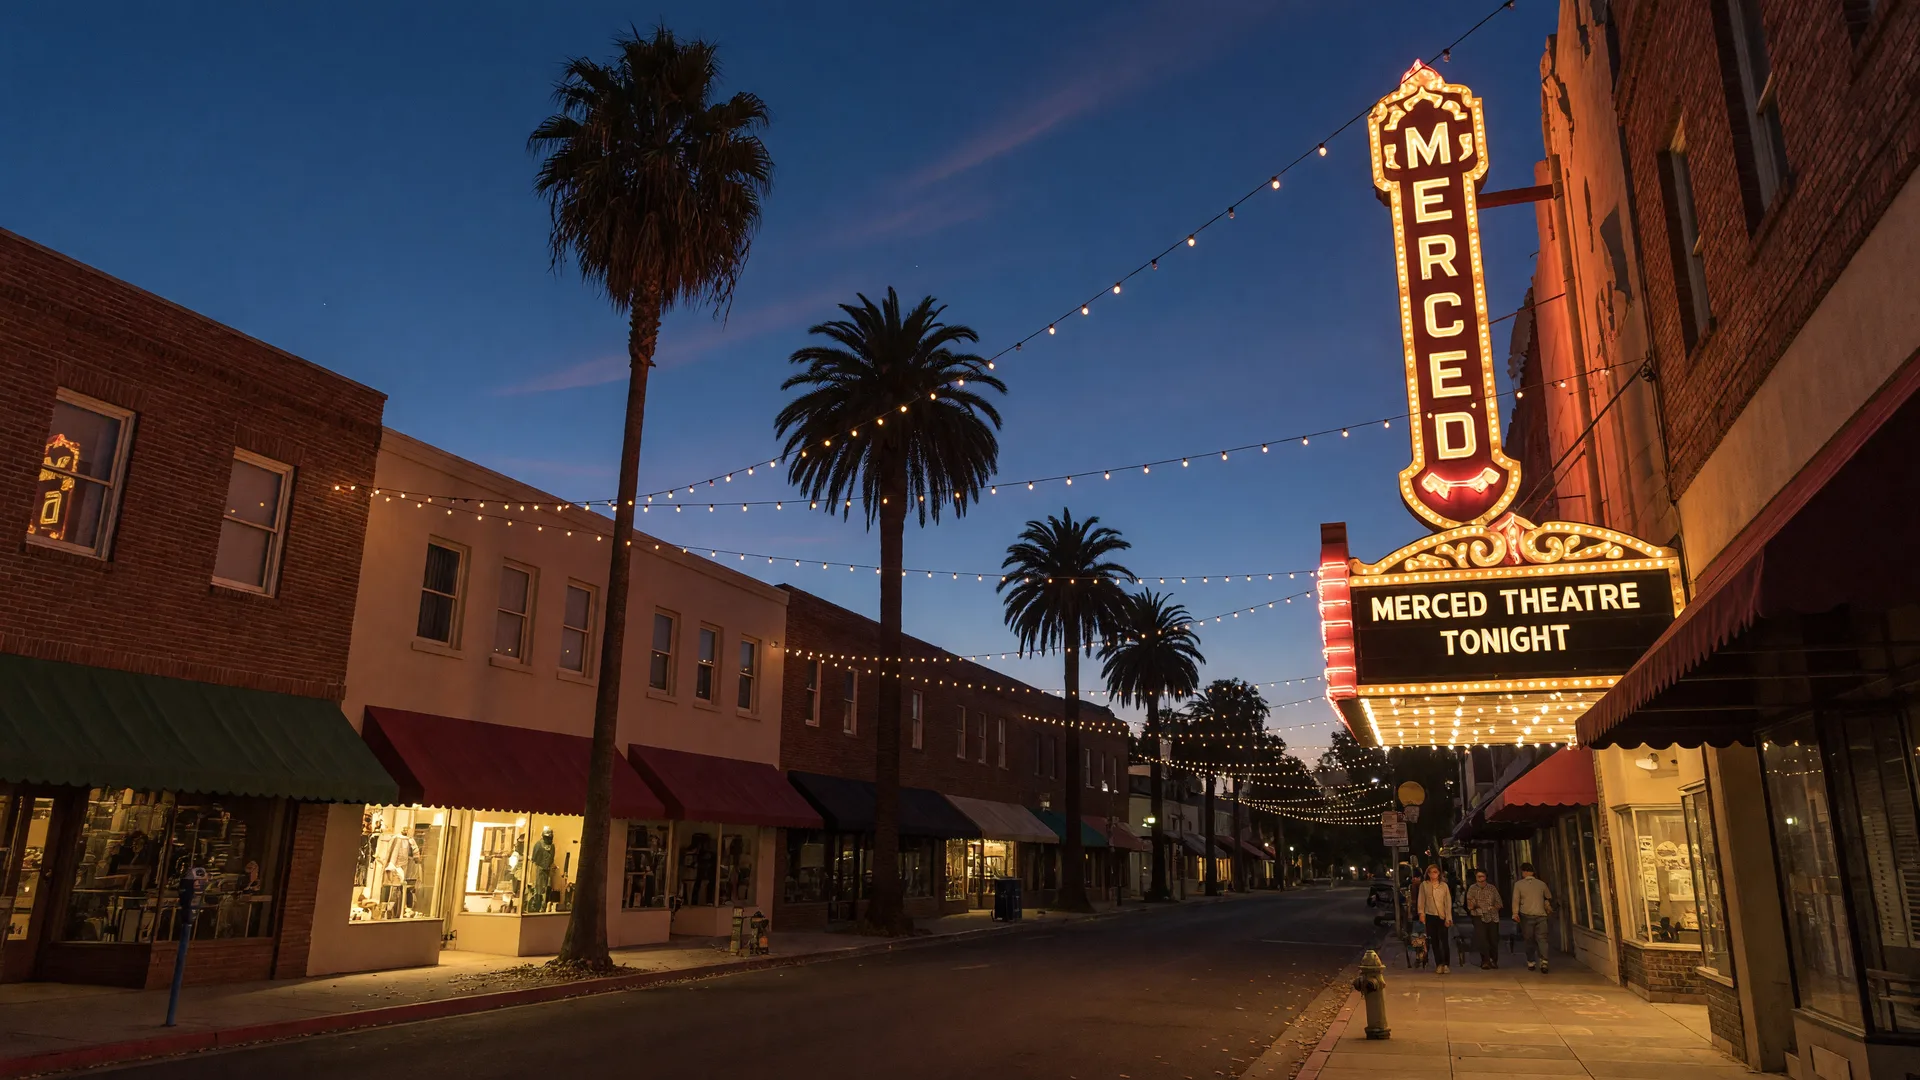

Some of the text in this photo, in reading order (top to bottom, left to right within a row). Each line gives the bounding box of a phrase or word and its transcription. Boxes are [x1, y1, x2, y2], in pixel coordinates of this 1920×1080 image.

[1404, 121, 1477, 460] MERCED
[1371, 582, 1641, 622] MERCED THEATRE
[1440, 624, 1570, 656] TONIGHT
